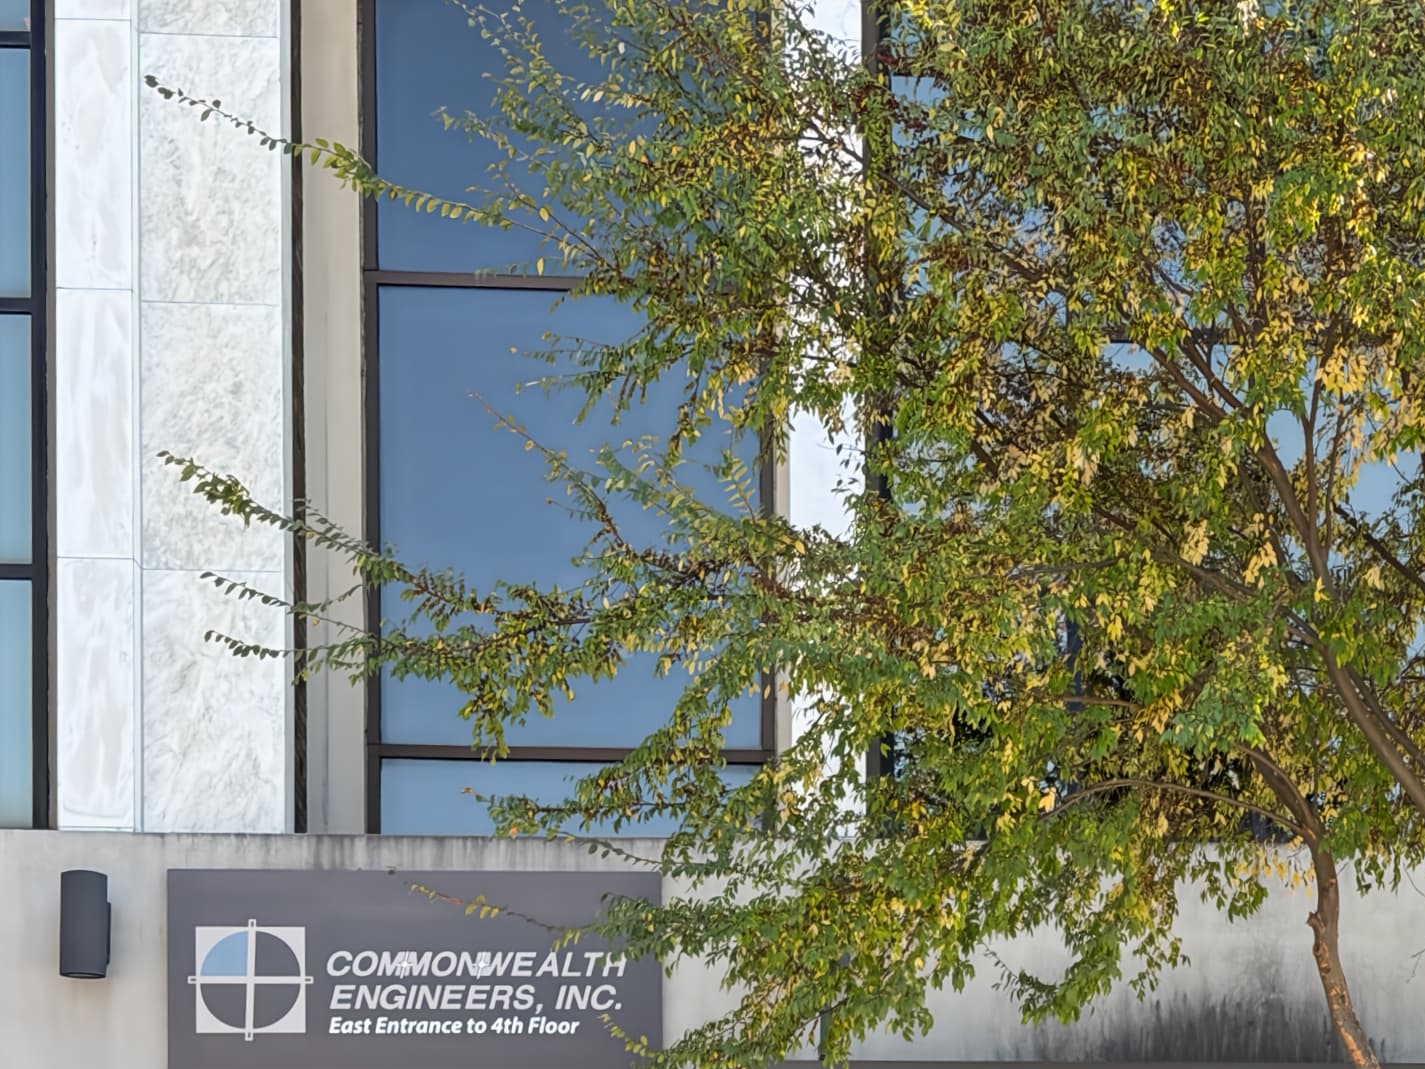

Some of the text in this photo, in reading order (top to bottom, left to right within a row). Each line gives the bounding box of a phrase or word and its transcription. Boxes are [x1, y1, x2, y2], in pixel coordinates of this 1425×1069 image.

[326, 950, 627, 977] COMMONWEALTH
[329, 984, 623, 1013] ENGINEERS, INC.
[329, 1016, 580, 1035] East Entrance to 4th Floor
